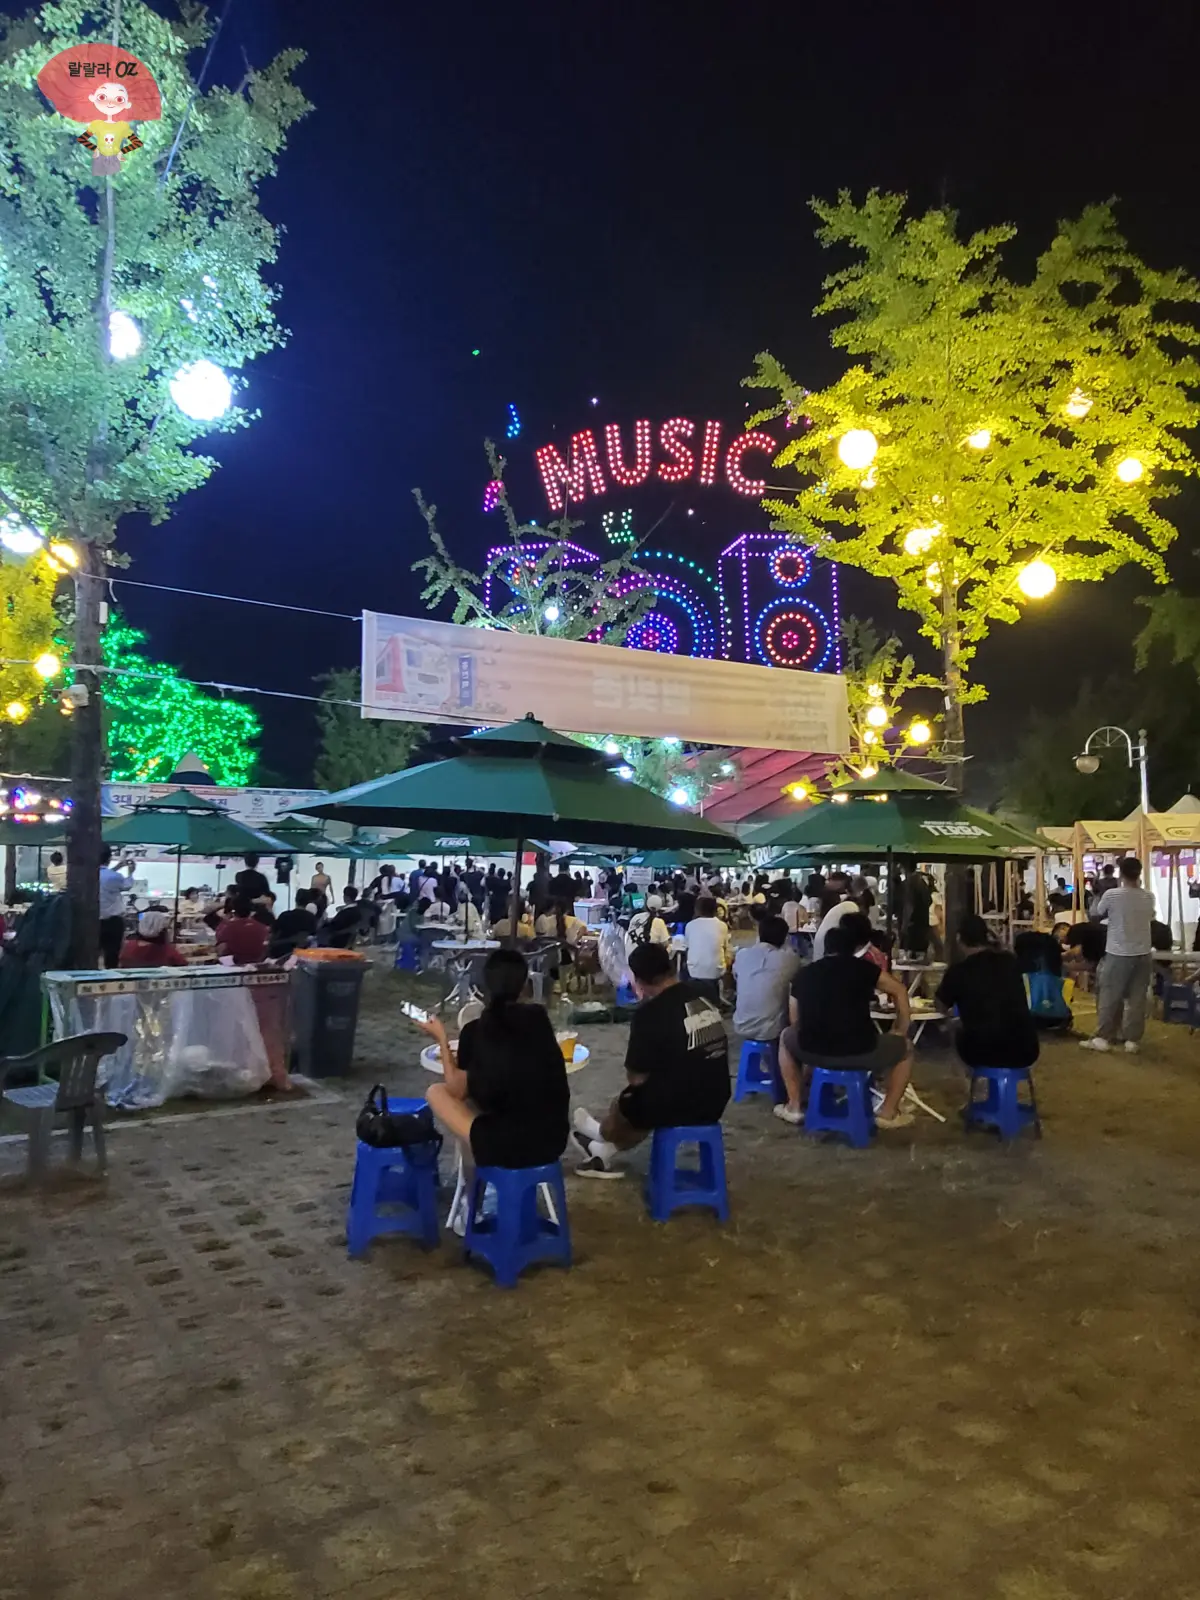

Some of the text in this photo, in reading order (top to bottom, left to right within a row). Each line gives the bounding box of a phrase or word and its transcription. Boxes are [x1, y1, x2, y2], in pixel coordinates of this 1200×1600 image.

[535, 416, 777, 511] MUSIC
[919, 824, 994, 837] TERRA
[433, 838, 471, 847] TERRA
